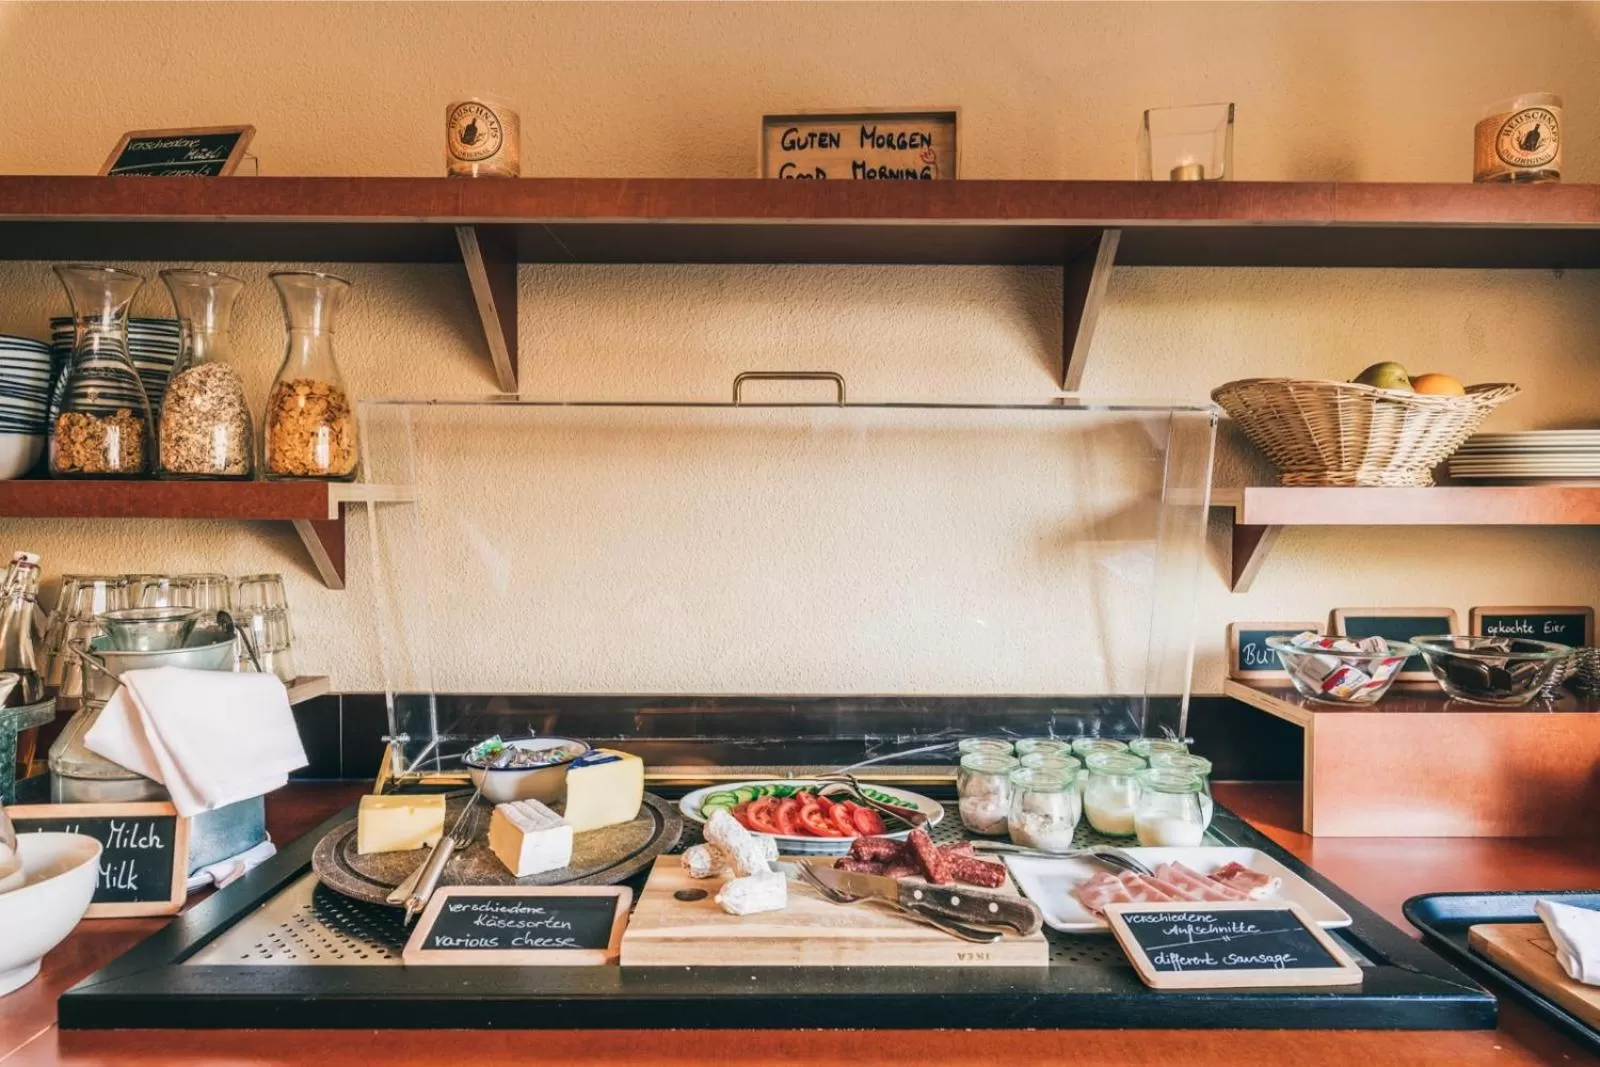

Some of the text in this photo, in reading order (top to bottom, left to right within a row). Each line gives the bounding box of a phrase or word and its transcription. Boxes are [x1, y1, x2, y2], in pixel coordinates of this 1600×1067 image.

[781, 124, 931, 150] GUTEN MORGEN
[1487, 620, 1566, 638] gekochte Eier
[1242, 643, 1276, 665] BUT
[106, 819, 164, 849] Milch
[473, 914, 572, 930] Käsesorten
[511, 931, 584, 948] cheese
